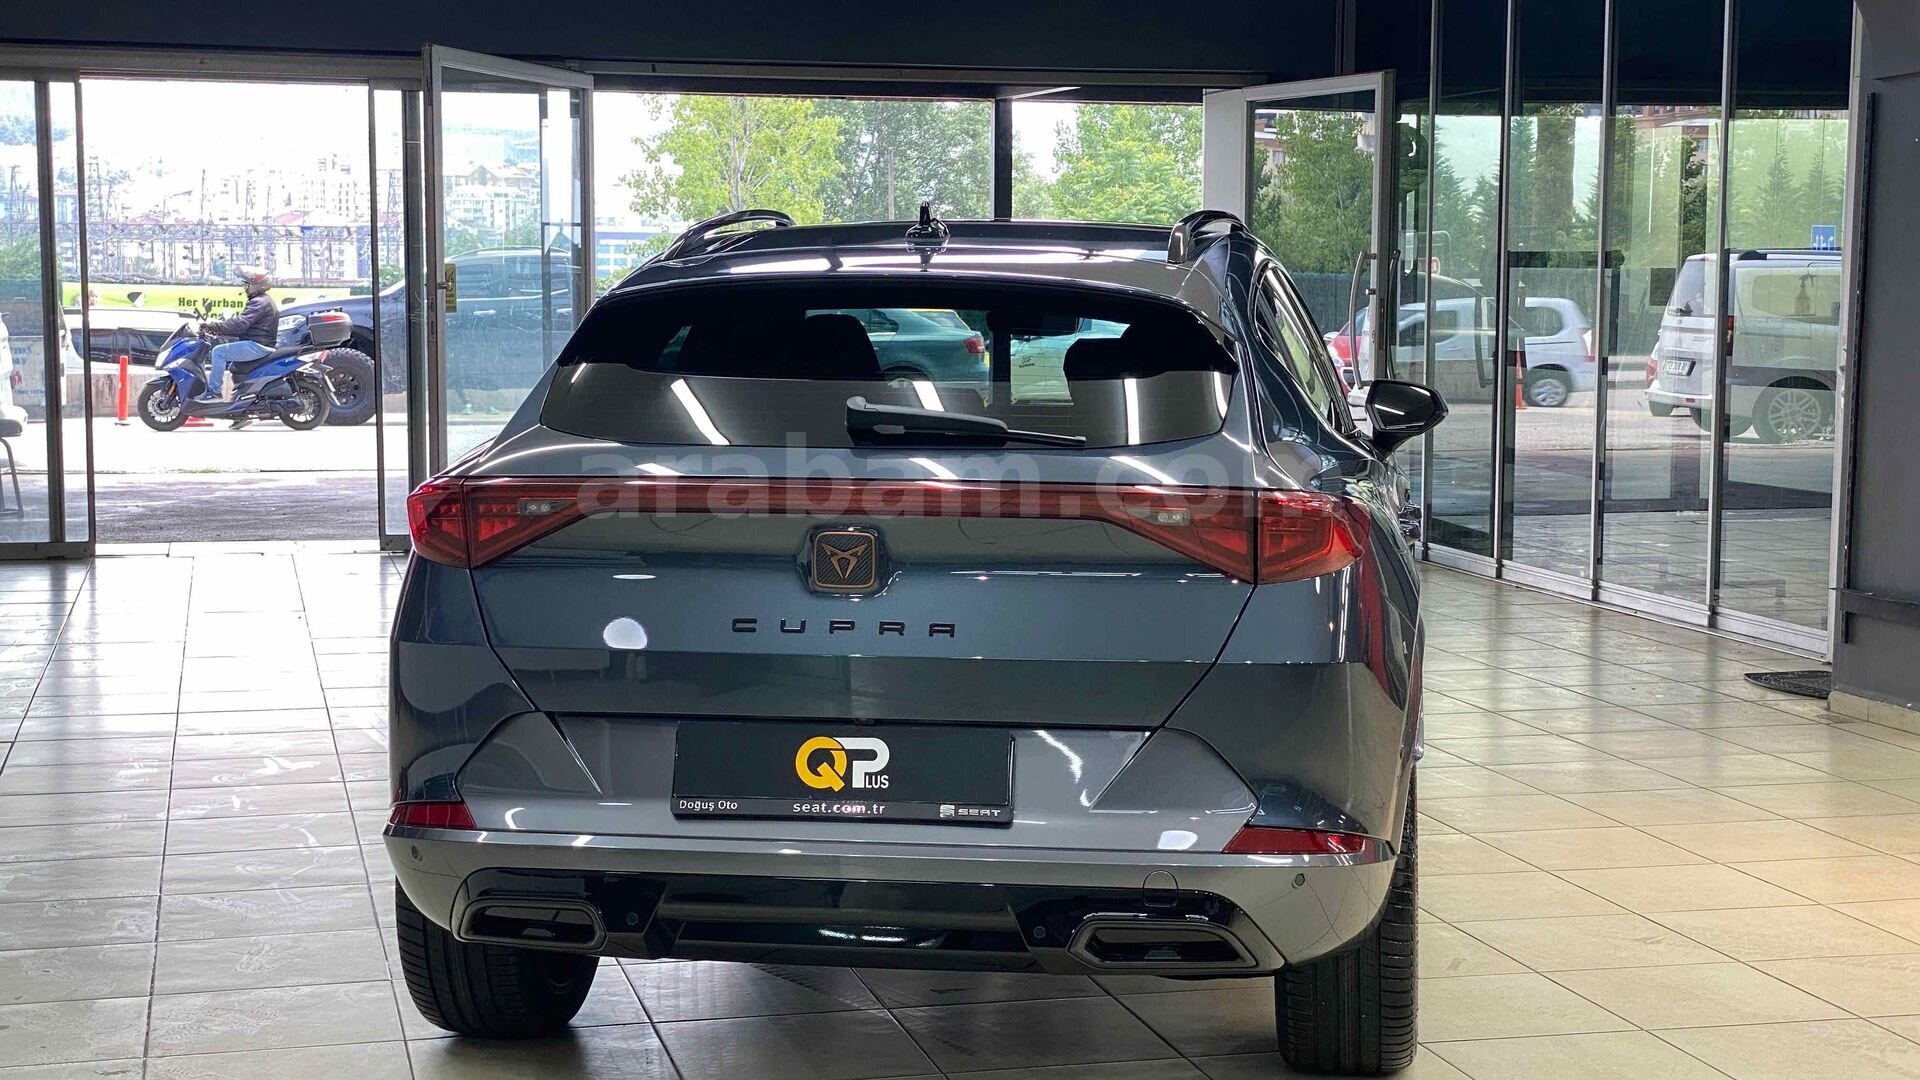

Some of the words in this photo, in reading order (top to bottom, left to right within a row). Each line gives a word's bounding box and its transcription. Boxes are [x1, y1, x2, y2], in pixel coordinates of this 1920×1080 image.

[178, 297, 198, 307] Her
[202, 297, 244, 308] Kurban
[732, 618, 956, 638] CUPRA
[680, 799, 715, 812] Doğuş
[717, 800, 738, 810] Oto
[793, 802, 885, 815] seat.com.tr
[958, 808, 1002, 817] SEAT
